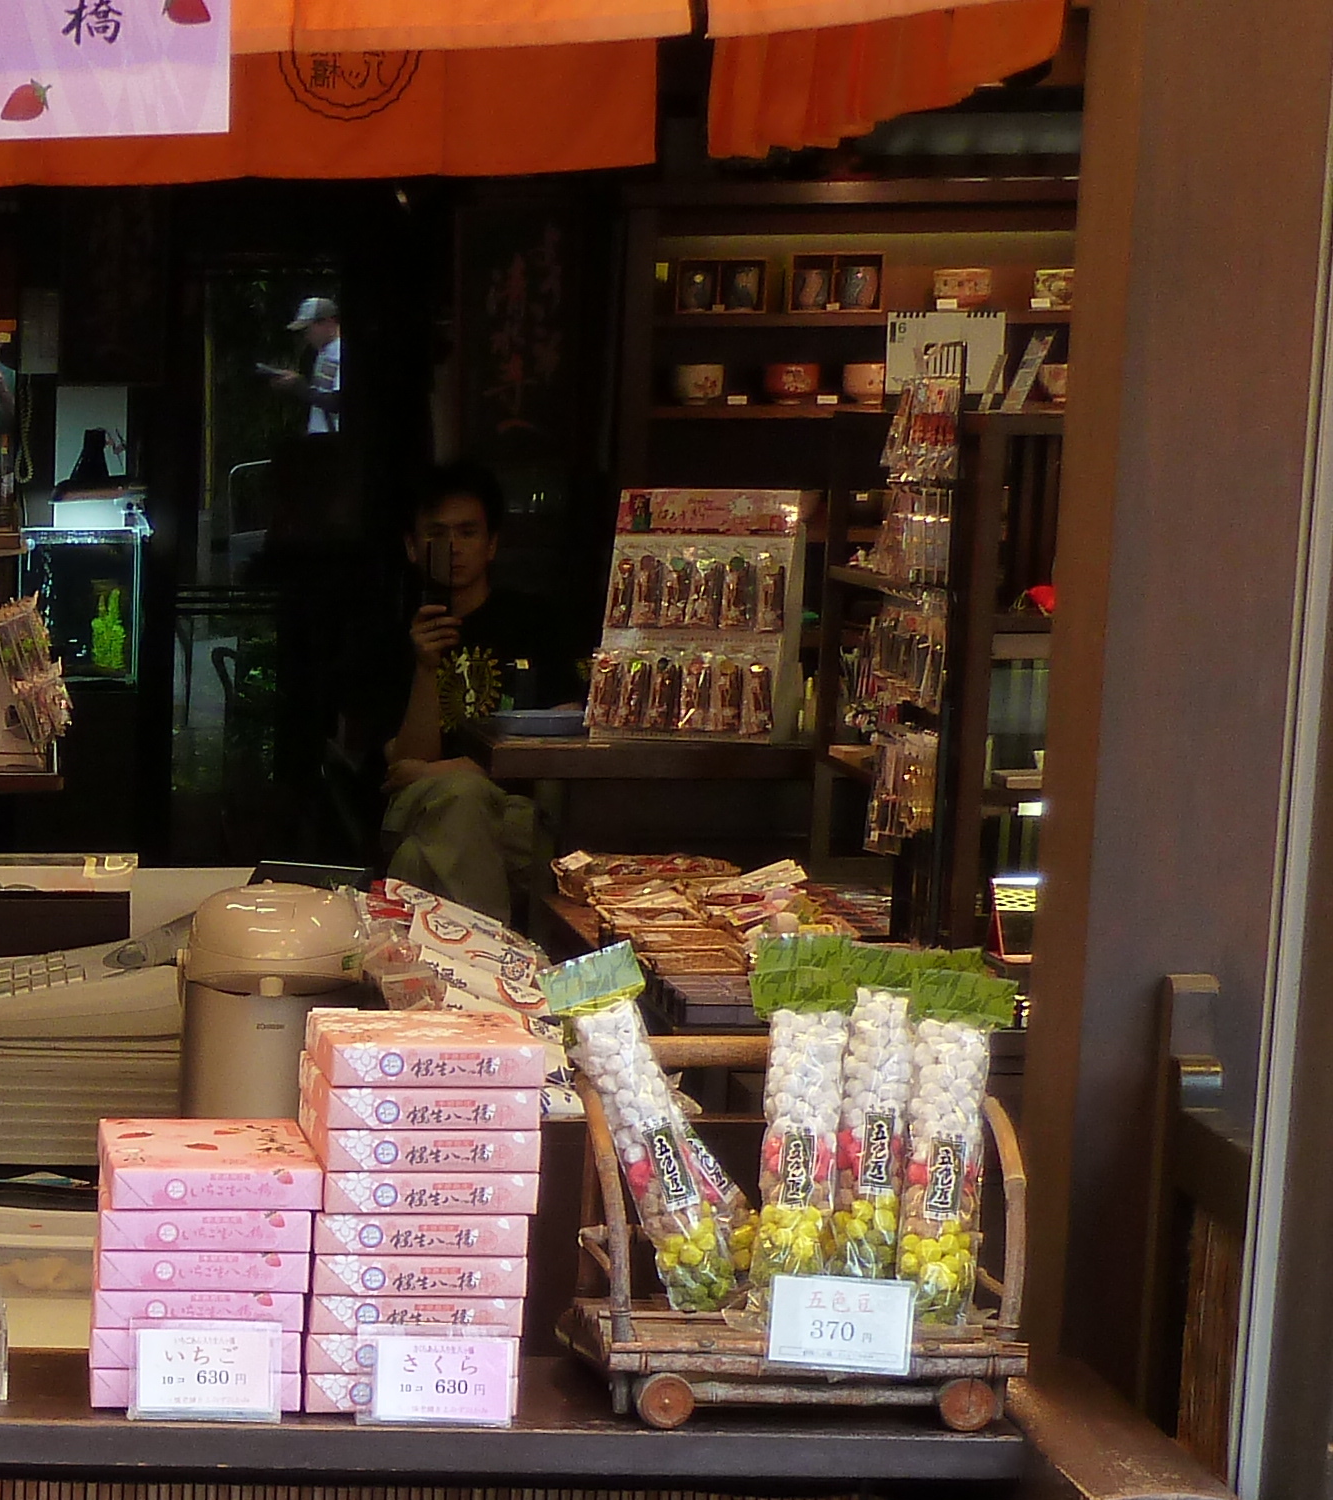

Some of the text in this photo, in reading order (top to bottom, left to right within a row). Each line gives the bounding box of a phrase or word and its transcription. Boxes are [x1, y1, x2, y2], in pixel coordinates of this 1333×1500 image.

[805, 1289, 874, 1314] 五色豆
[809, 1320, 856, 1342] 370
[165, 1345, 239, 1366] いちご
[401, 1352, 480, 1376] さくら
[196, 1369, 230, 1385] 630
[235, 1372, 247, 1386] 円
[434, 1377, 469, 1396] 630
[474, 1384, 486, 1397] 円
